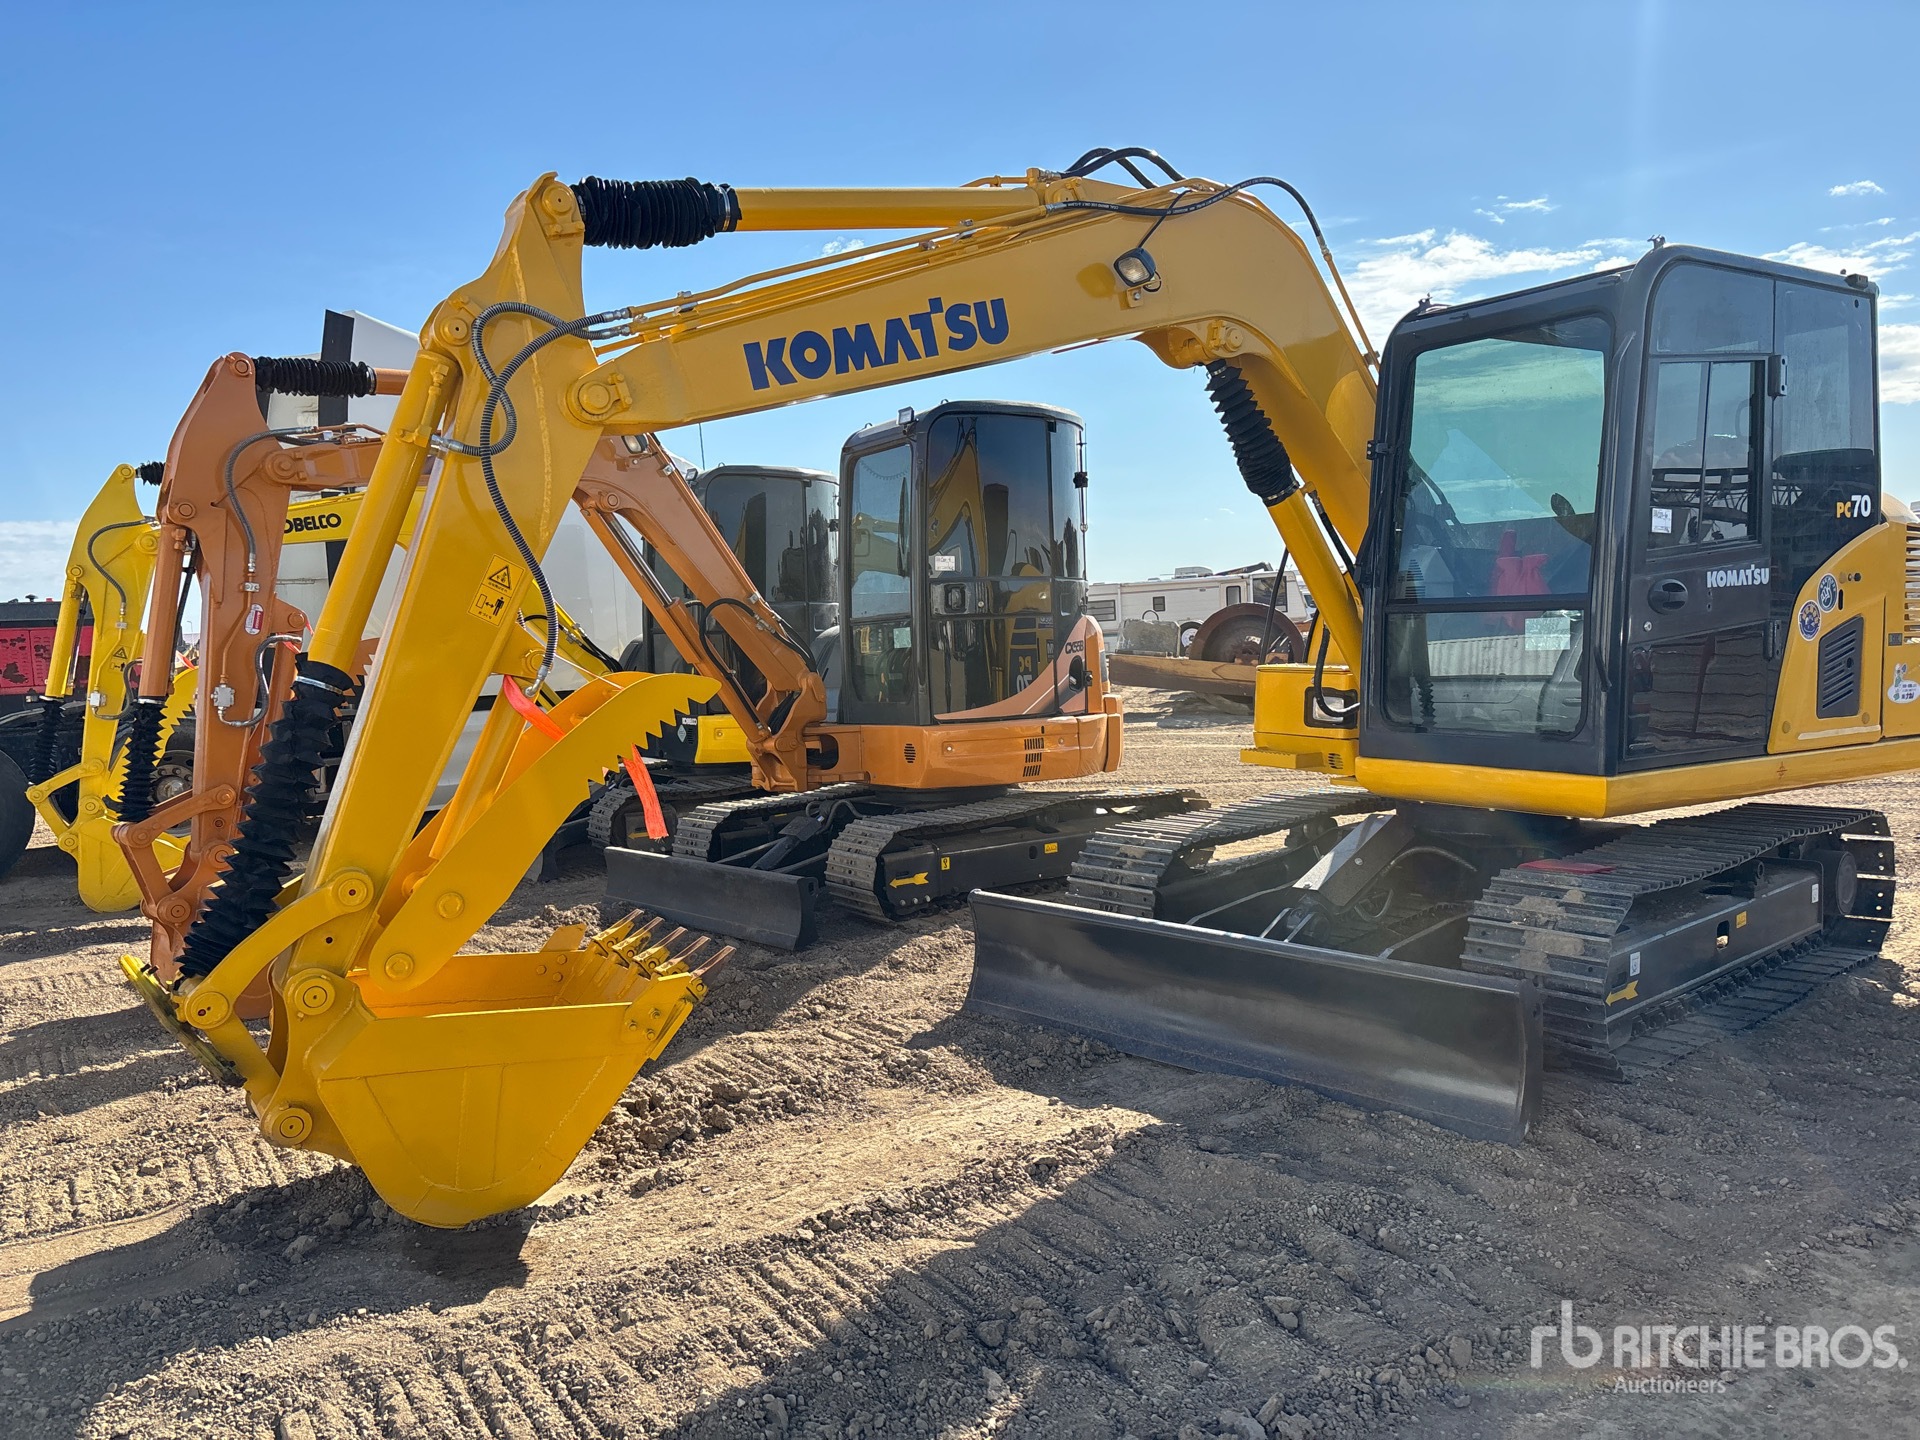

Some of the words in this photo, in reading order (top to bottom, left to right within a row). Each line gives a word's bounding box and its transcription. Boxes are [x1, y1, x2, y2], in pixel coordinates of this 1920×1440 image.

[743, 296, 1010, 391] KOMATSU
[1836, 494, 1872, 519] PC70
[284, 513, 342, 534] OBELCO
[1706, 564, 1770, 588] KOMATSU
